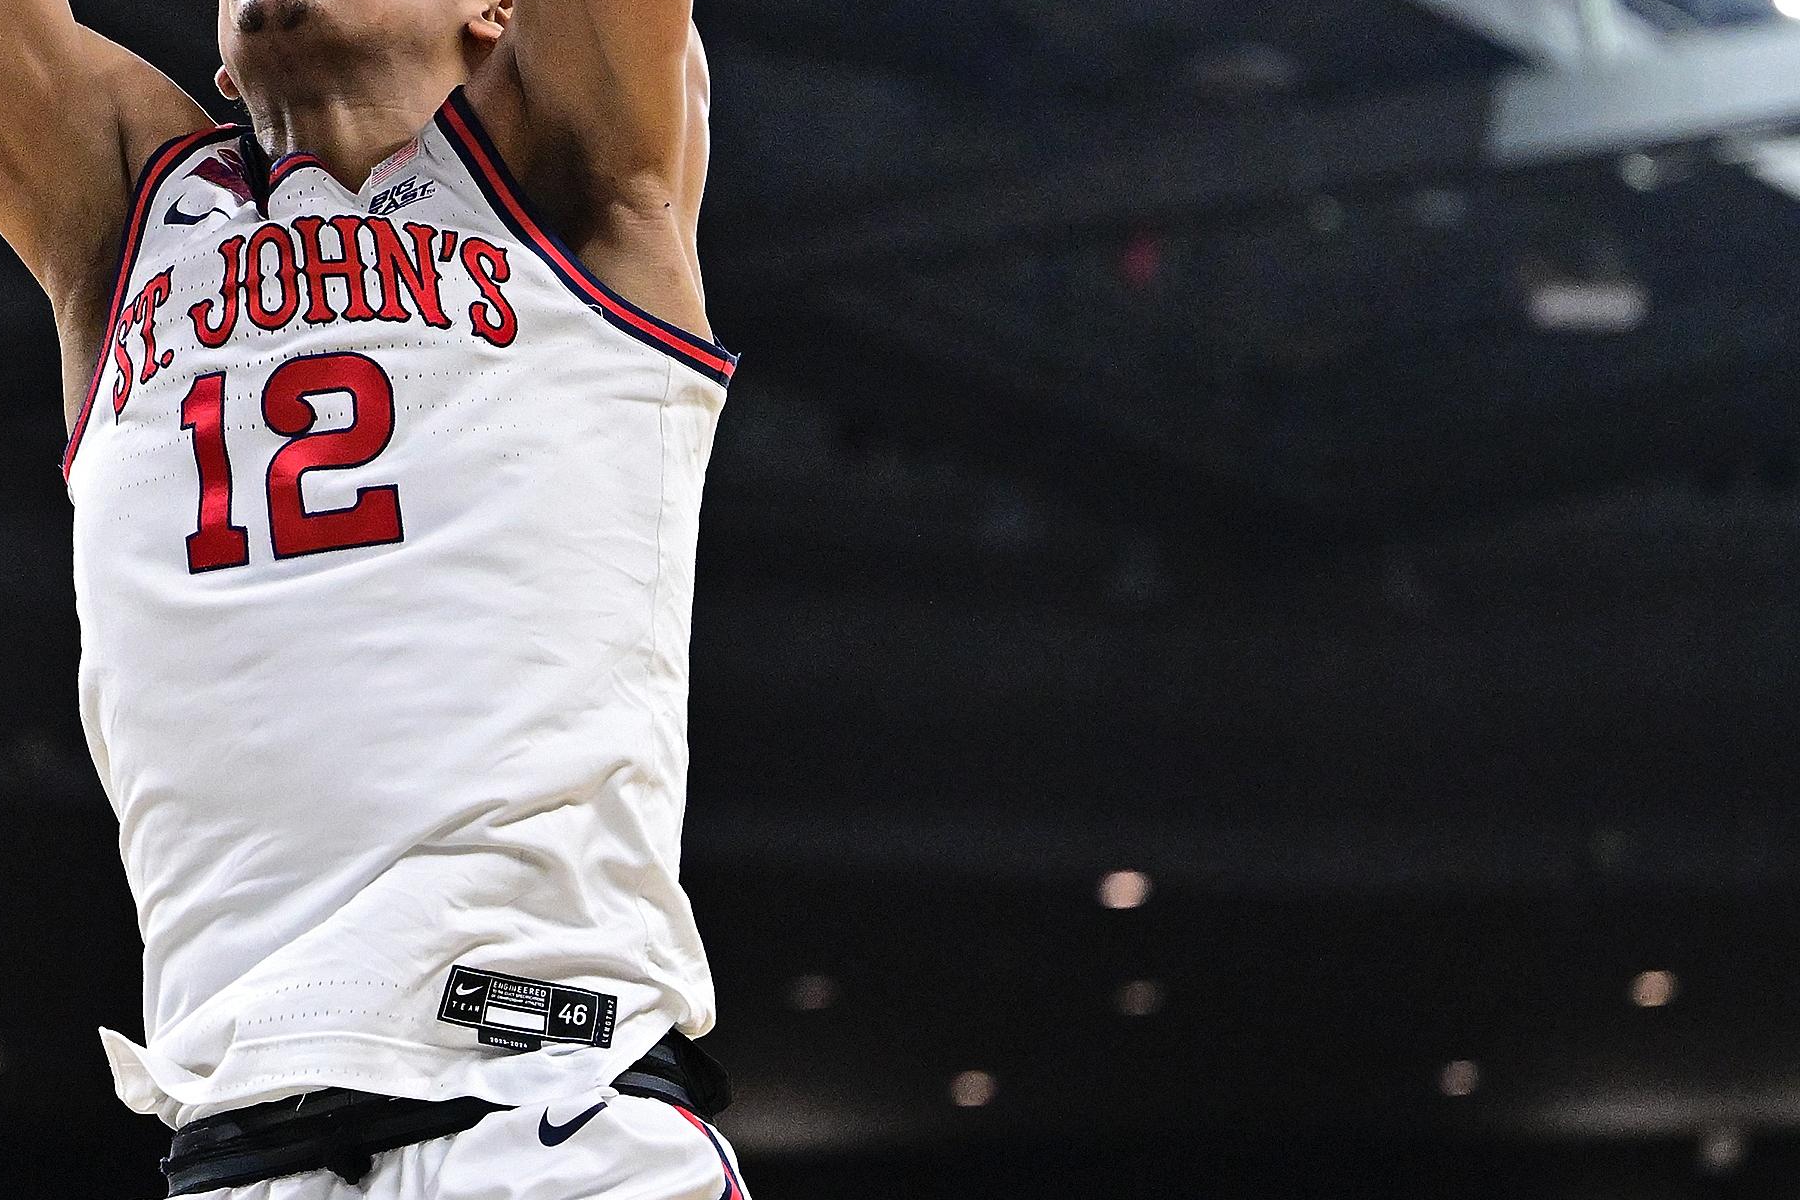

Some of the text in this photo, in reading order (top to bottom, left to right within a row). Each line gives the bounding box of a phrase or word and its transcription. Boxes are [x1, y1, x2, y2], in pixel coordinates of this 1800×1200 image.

[369, 175, 418, 209] BIG
[112, 215, 518, 420] ST. JOHN'S
[180, 351, 405, 575] 12
[493, 980, 547, 998] ENGINEERED
[558, 1003, 589, 1026] 46
